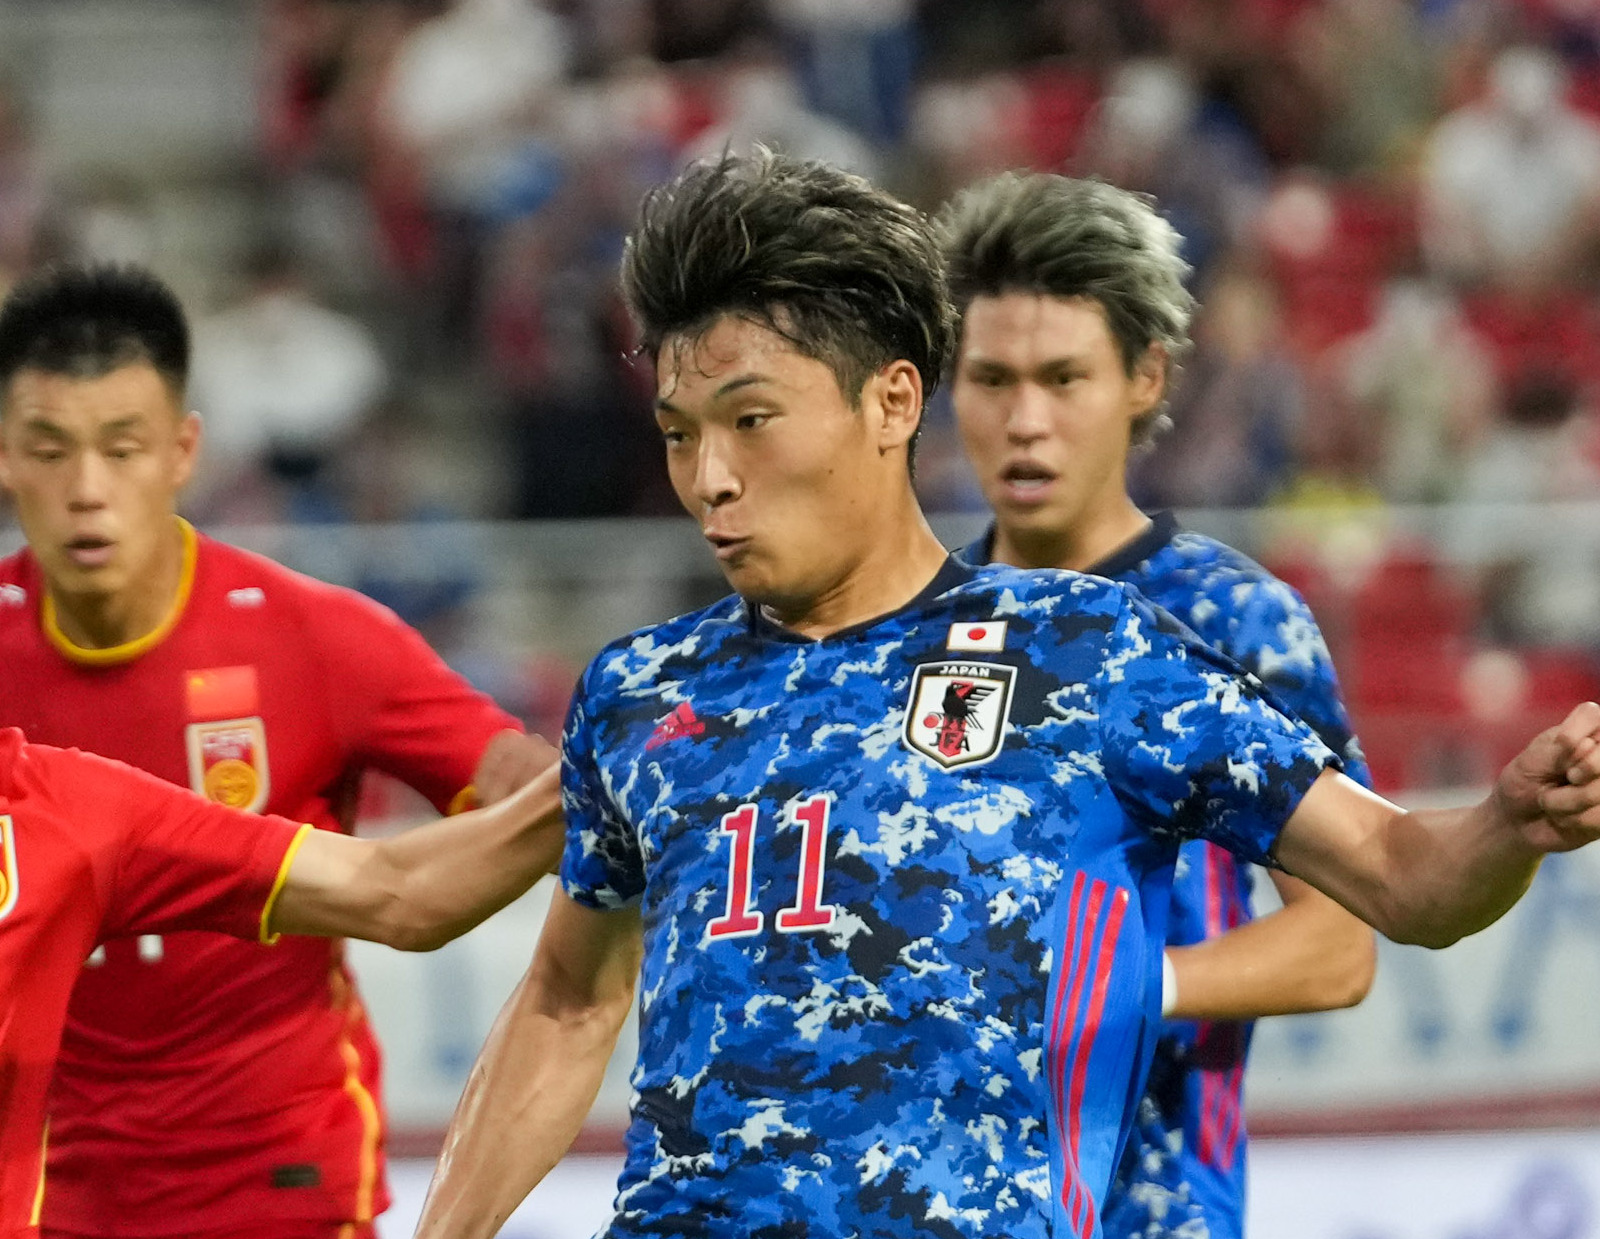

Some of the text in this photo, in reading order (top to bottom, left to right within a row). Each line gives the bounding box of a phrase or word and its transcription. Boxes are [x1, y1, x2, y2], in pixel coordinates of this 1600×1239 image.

[939, 665, 990, 677] JAPAN
[928, 730, 970, 752] JFA
[707, 791, 839, 941] 11
